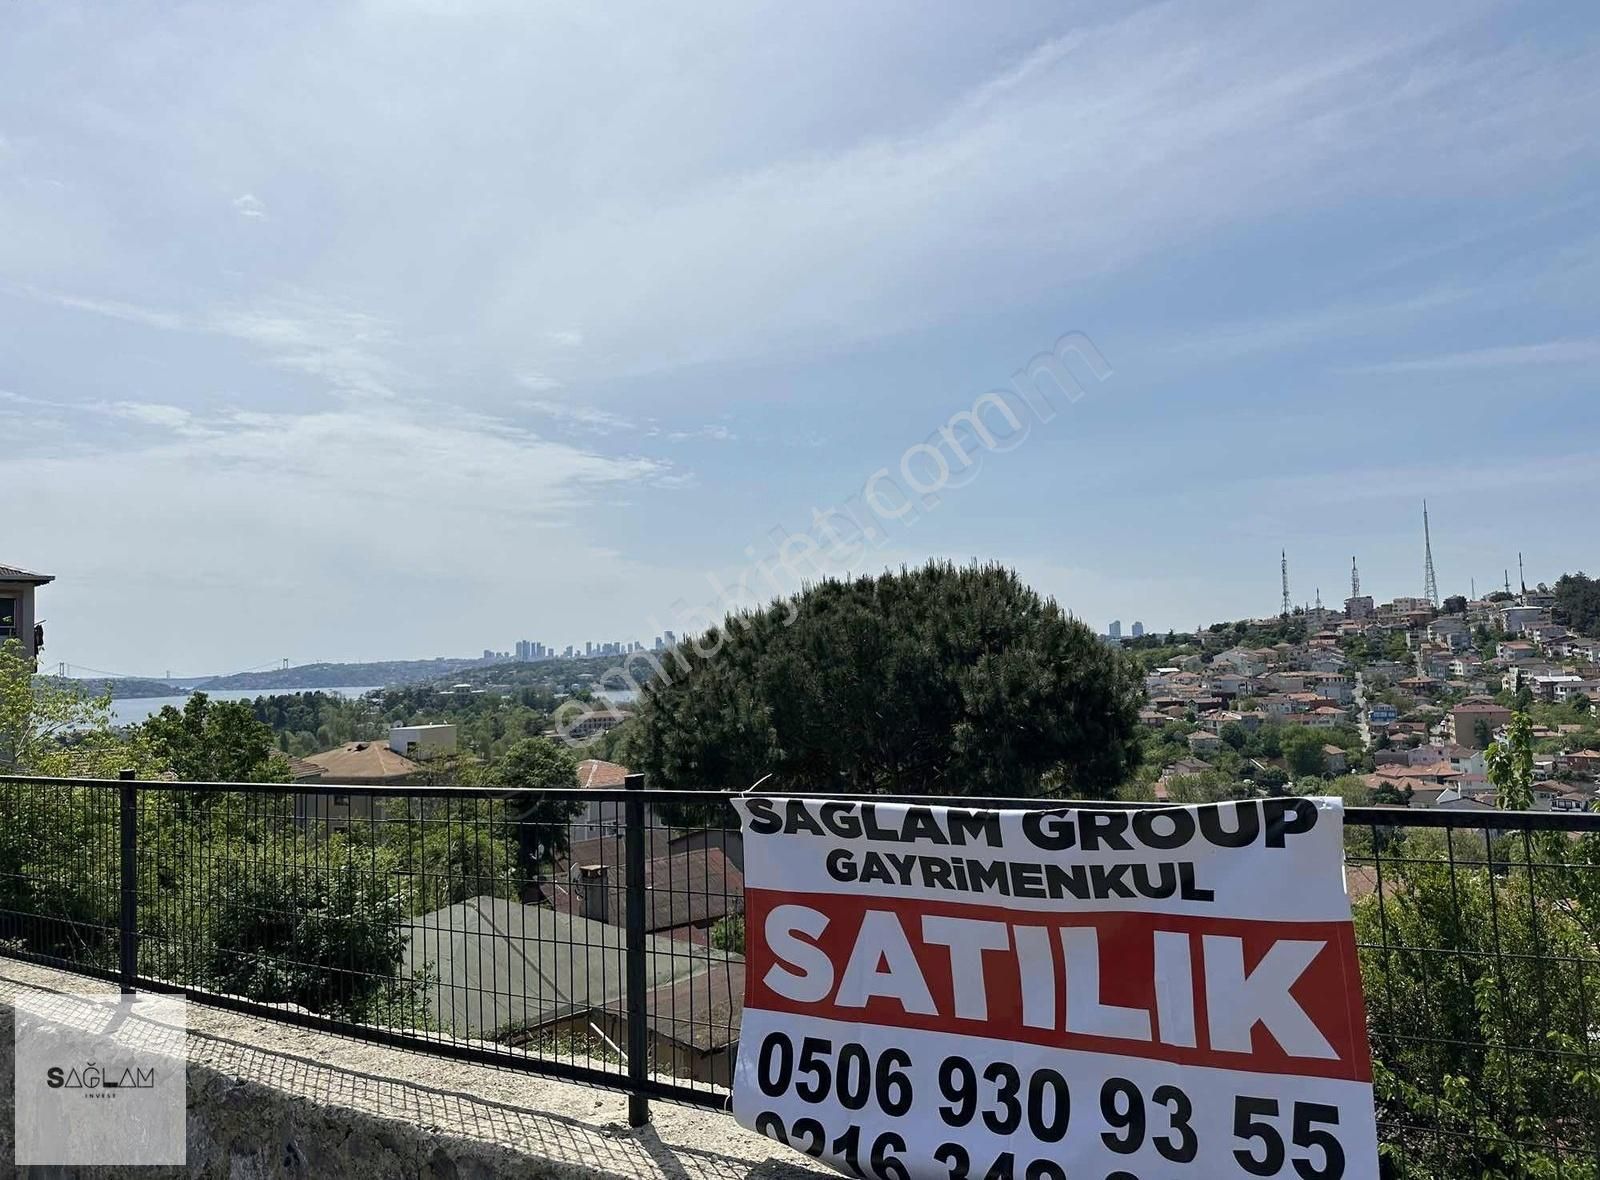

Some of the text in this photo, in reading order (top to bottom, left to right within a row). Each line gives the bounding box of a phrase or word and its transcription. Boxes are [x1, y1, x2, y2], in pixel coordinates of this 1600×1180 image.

[1021, 797, 1319, 851] GROUP
[762, 904, 1342, 1061] SATILIK
[758, 1032, 913, 1117] 0506
[938, 1055, 1071, 1143] 930
[1100, 1077, 1198, 1164] 93
[1232, 1095, 1346, 1180] 55
